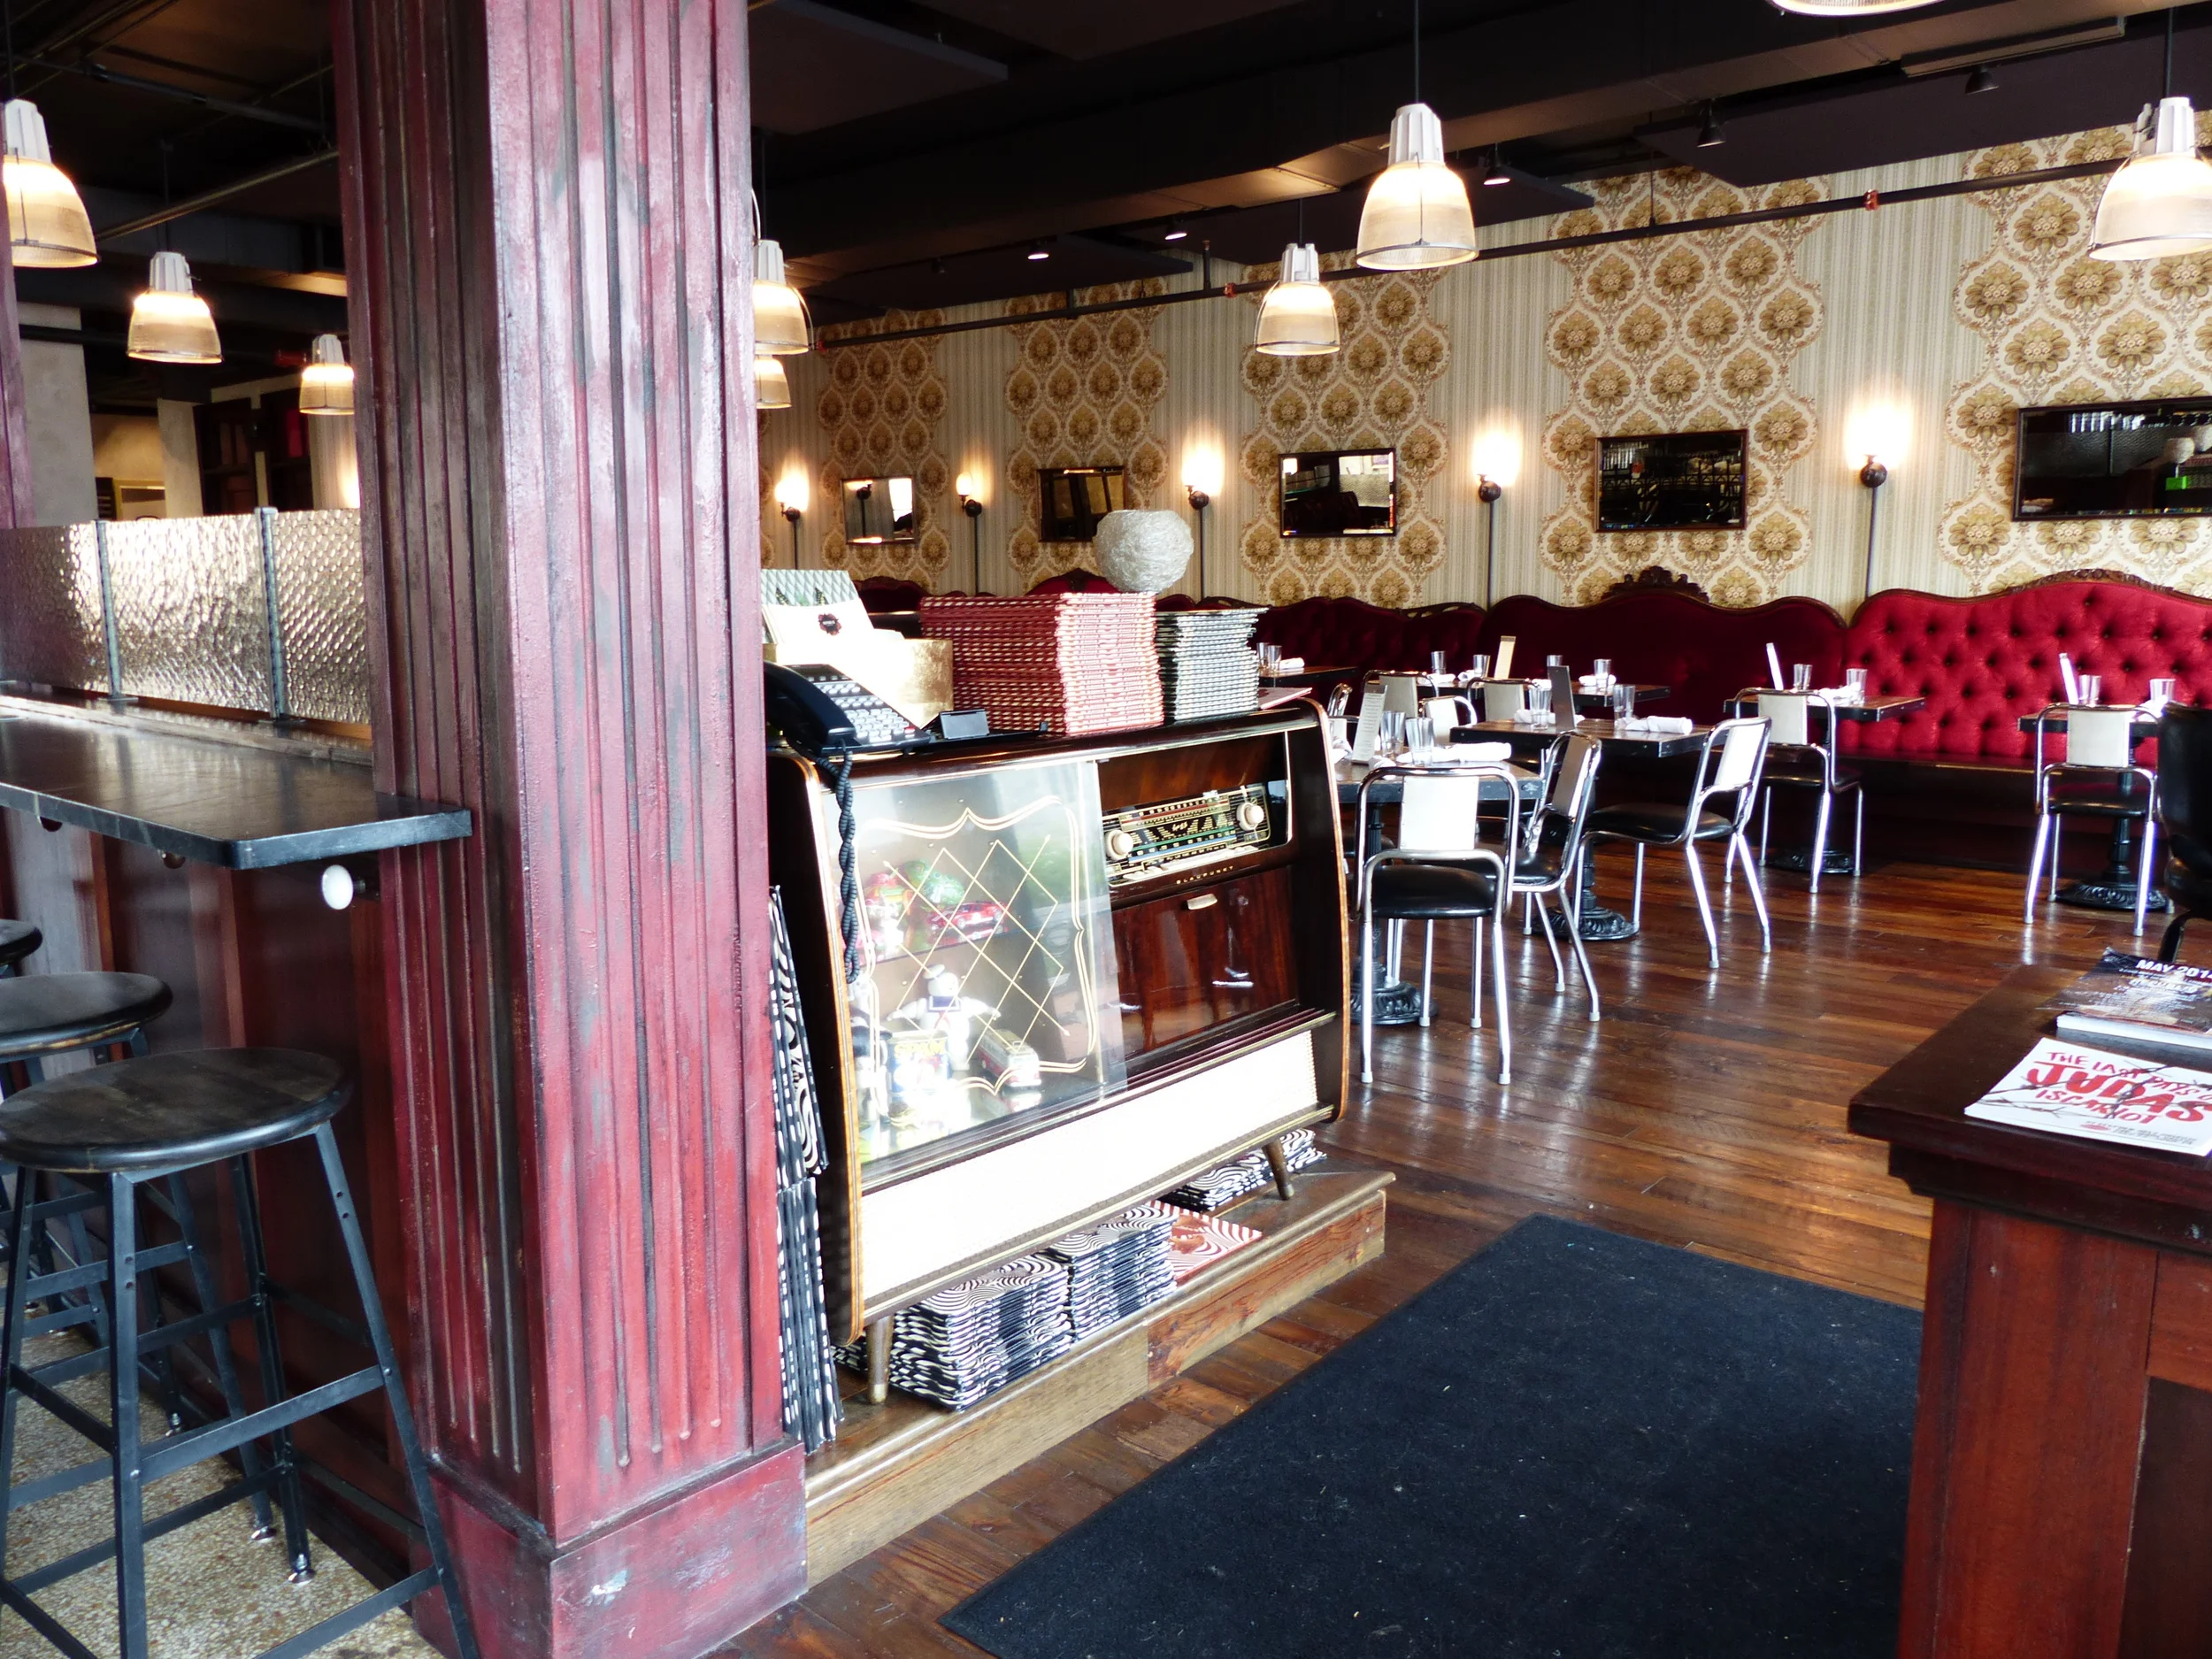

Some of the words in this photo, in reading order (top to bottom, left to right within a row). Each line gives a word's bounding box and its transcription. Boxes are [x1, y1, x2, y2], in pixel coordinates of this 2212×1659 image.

[1176, 865, 1233, 885] BLAUPUNKT
[2135, 959, 2175, 973] MAY
[2047, 1051, 2088, 1065] THE
[2092, 1061, 2149, 1079] LAST
[2148, 1076, 2200, 1096] DAYS
[2026, 1061, 2212, 1122] JUDAS
[2035, 1089, 2157, 1124] ISCARIOT
